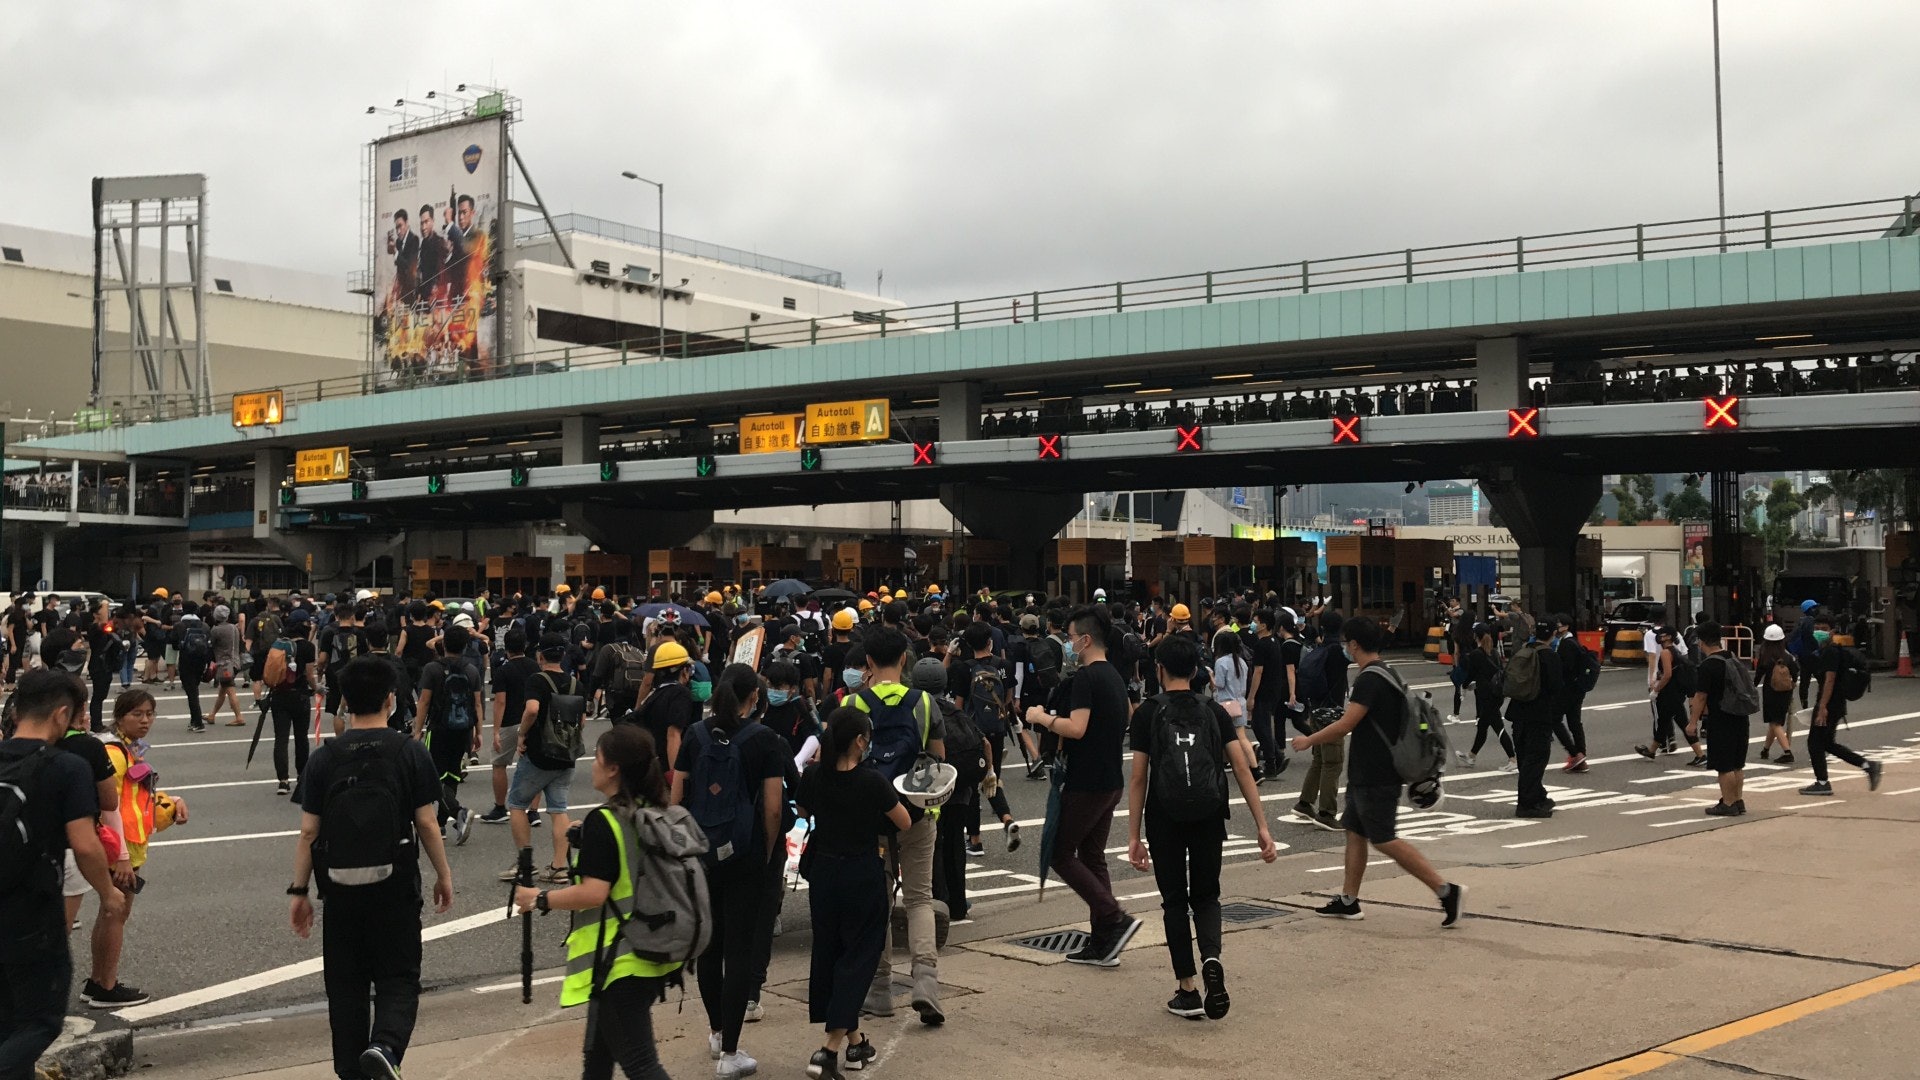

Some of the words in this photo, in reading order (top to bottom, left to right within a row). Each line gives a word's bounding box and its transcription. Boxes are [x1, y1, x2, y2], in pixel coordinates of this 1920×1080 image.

[240, 397, 262, 406] Autotoll
[268, 397, 278, 421] A
[816, 407, 855, 418] Autotoll
[866, 406, 883, 433] A
[750, 420, 785, 431] Autotoll
[811, 421, 861, 437] 自動繳費
[744, 434, 791, 449] 自動繳費
[303, 453, 328, 462] Autotoll
[334, 452, 344, 474] A
